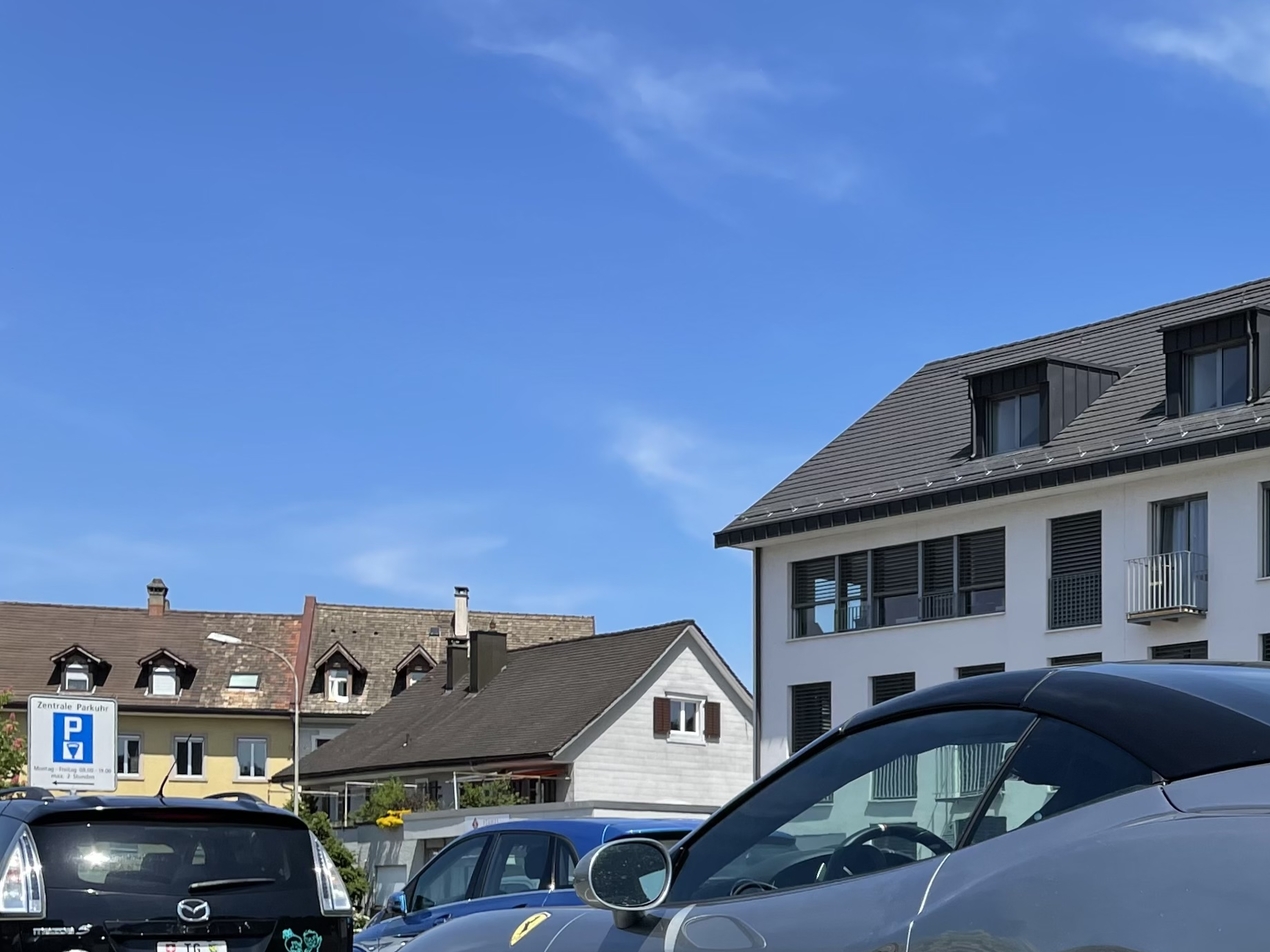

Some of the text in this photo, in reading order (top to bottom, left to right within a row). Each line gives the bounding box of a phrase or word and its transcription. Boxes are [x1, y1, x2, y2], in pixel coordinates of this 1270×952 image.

[37, 701, 109, 712] Zentrale Parkuhr
[64, 716, 83, 741] P
[34, 765, 54, 773] Montag
